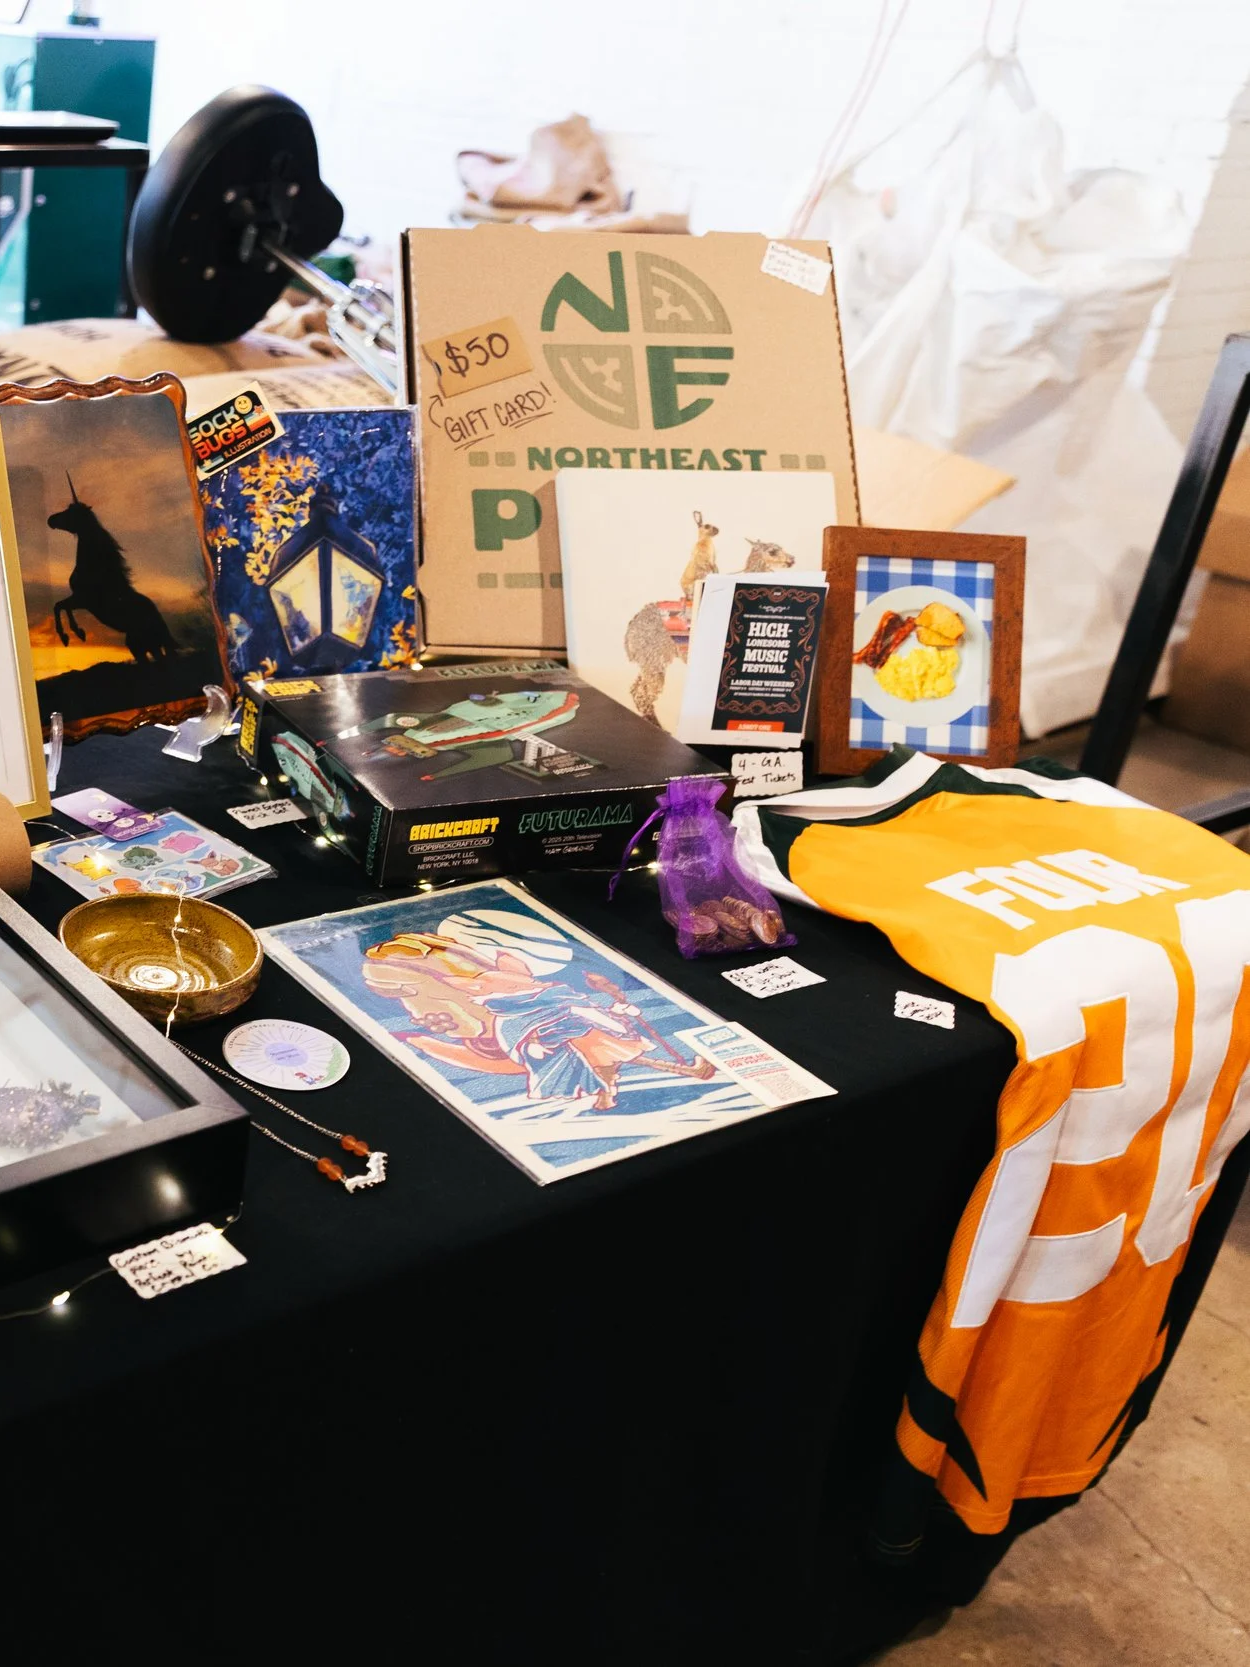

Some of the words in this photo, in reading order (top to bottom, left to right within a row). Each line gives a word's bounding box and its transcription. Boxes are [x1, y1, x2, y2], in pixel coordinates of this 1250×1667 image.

[444, 329, 510, 378] $50
[189, 406, 245, 443] SOCK
[444, 409, 492, 446] GIFT
[195, 420, 248, 459] BUGS
[223, 427, 273, 459] ILLUSTRATION
[527, 447, 768, 472] NORTHEAST
[747, 621, 794, 638] HIGH-
[743, 648, 789, 663] MUSIC
[745, 638, 791, 649] LONESOME
[741, 663, 786, 674] FESTIVAL
[738, 759, 746, 771] 4
[762, 772, 797, 783] Tickets
[409, 816, 500, 842] BRICKCRAFT
[518, 802, 633, 835] FUTURAMA
[412, 838, 491, 853] SHOPBRICKCRAFT.COM
[417, 862, 432, 870] NEW
[925, 848, 1191, 933] FOUR
